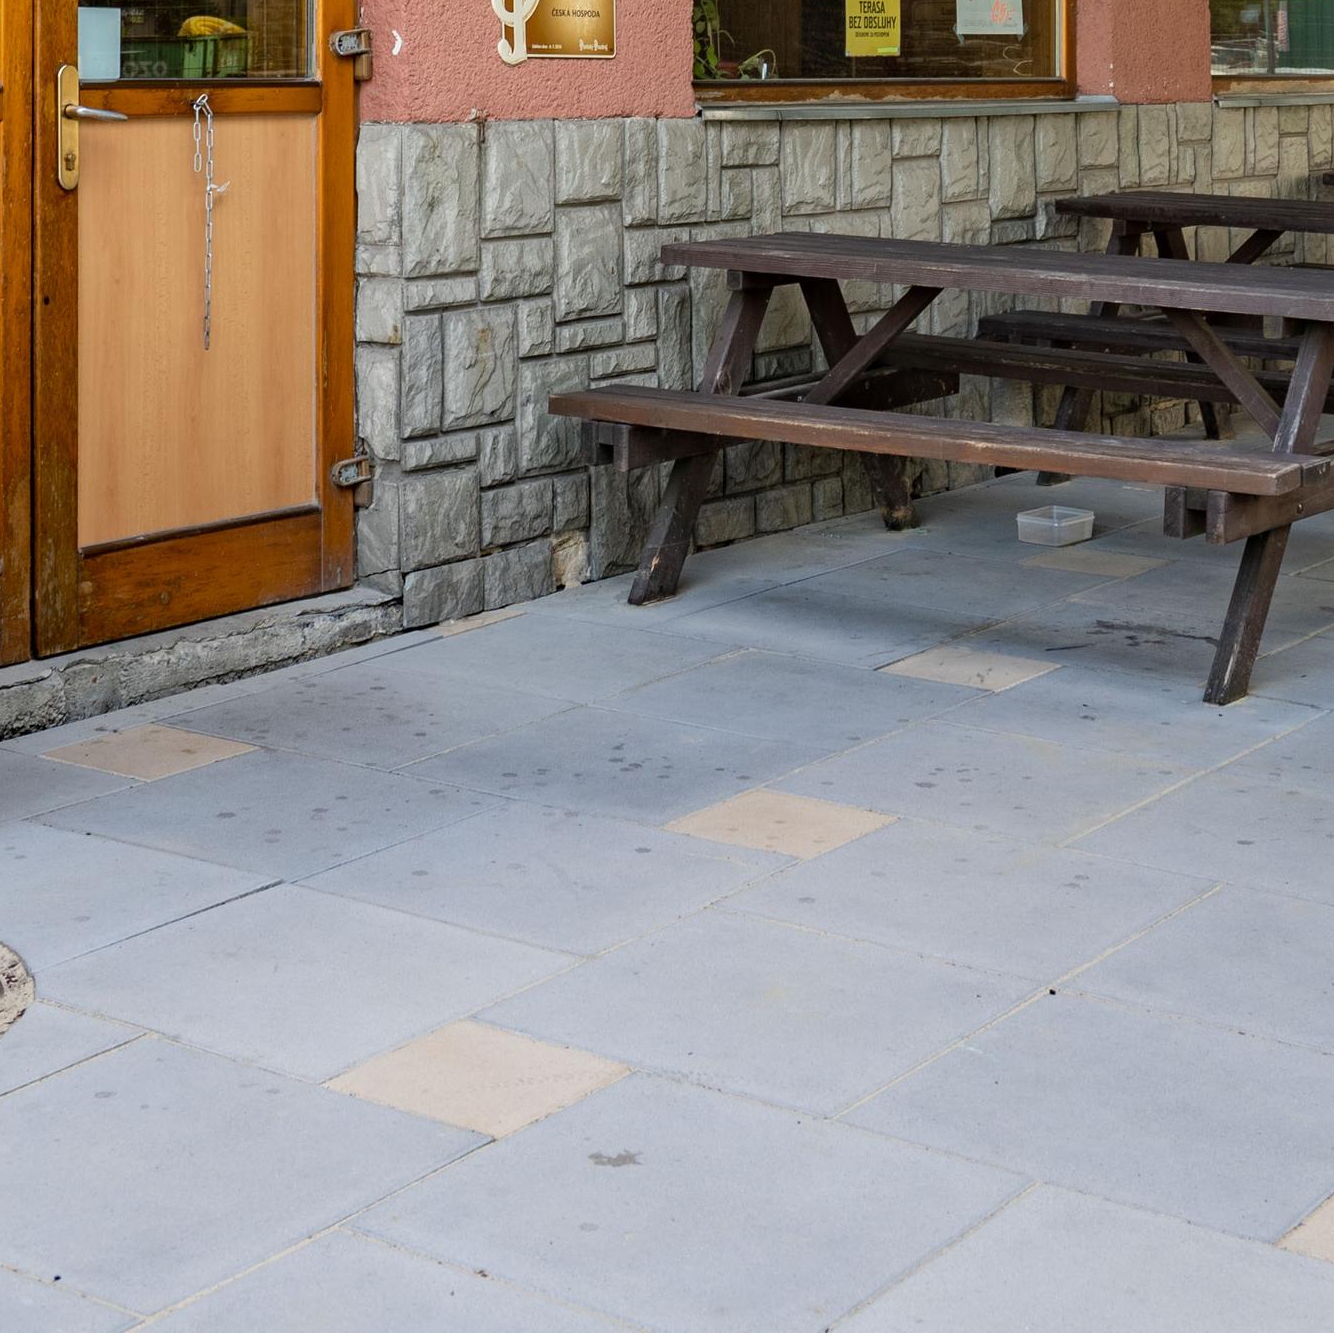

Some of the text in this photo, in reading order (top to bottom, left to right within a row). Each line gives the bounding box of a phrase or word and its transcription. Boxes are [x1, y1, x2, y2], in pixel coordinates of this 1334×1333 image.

[572, 9, 600, 18] HOSPODA
[859, 1, 885, 14] TERASA
[849, 16, 897, 29] BEZ OBSLUHY
